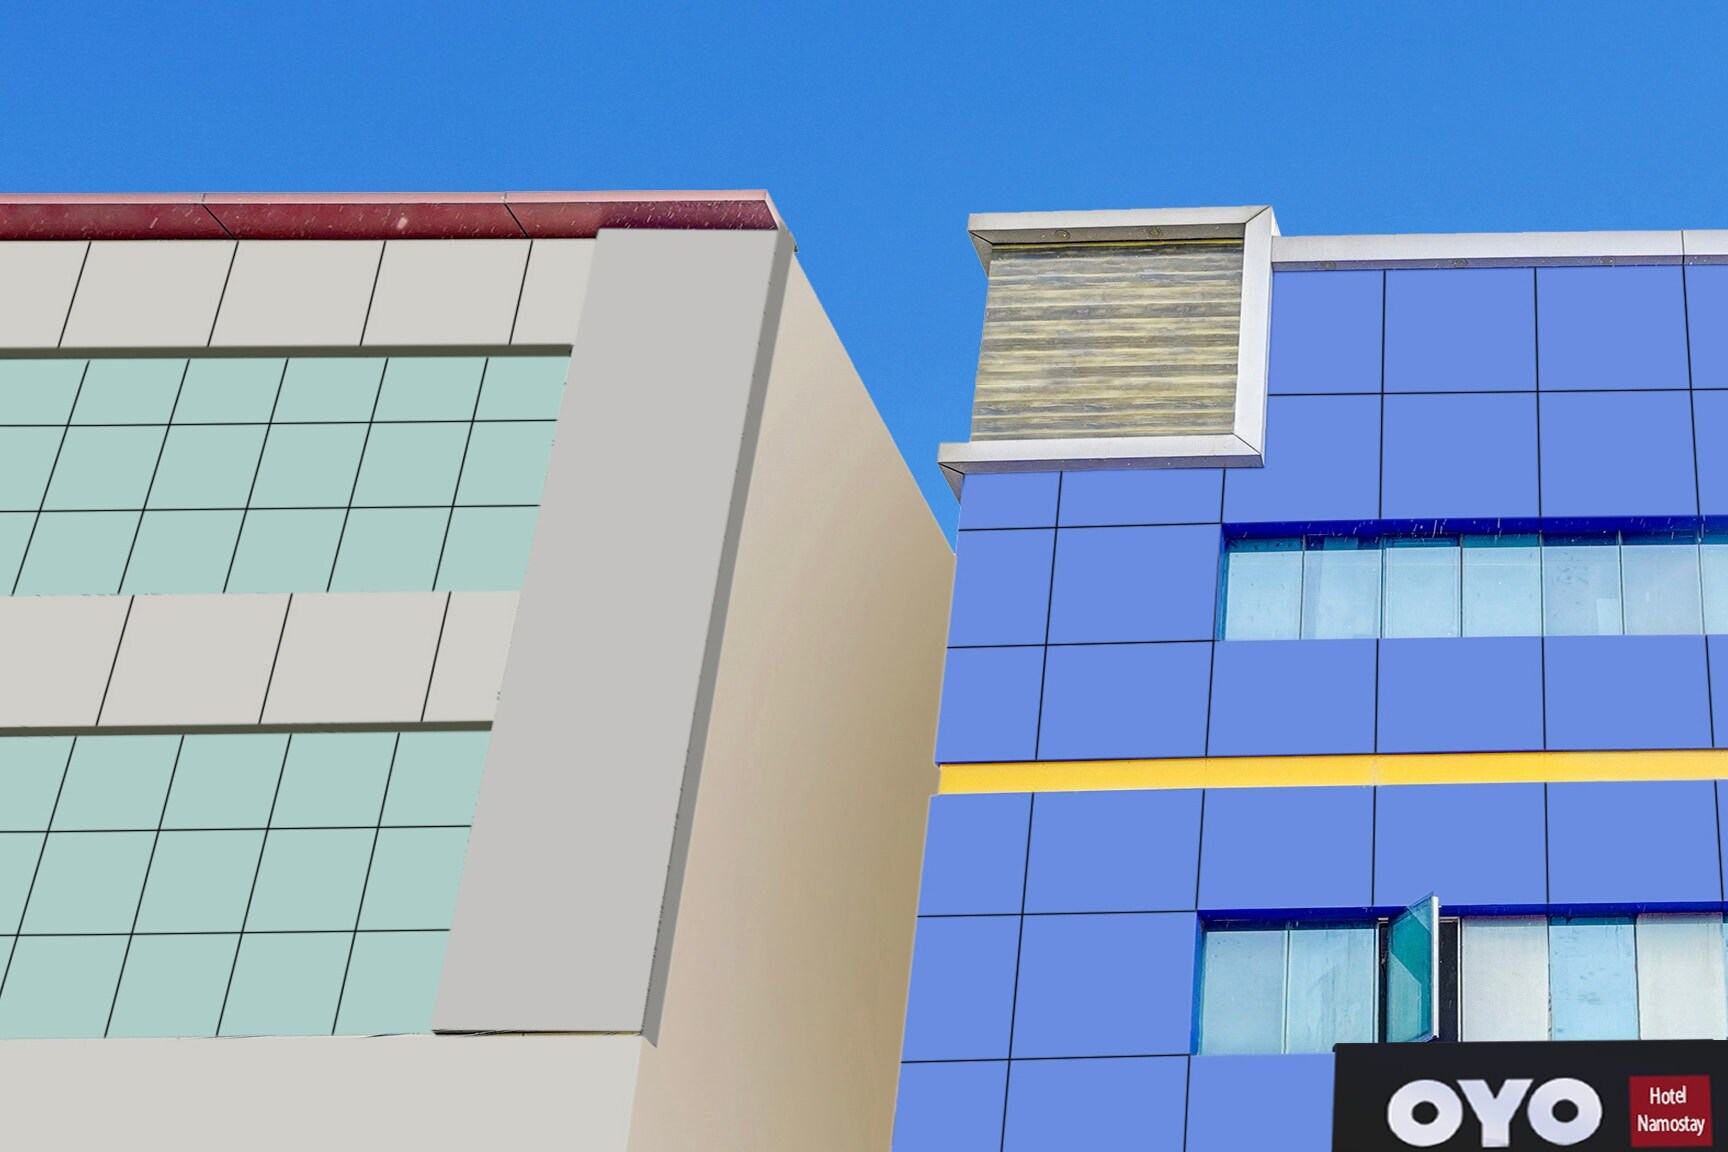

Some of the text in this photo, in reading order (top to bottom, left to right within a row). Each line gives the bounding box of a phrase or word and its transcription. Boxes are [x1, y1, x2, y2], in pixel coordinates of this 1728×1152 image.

[1650, 1085, 1686, 1104] Hotel
[1387, 1077, 1603, 1148] OYO
[1637, 1114, 1705, 1136] Namostay
